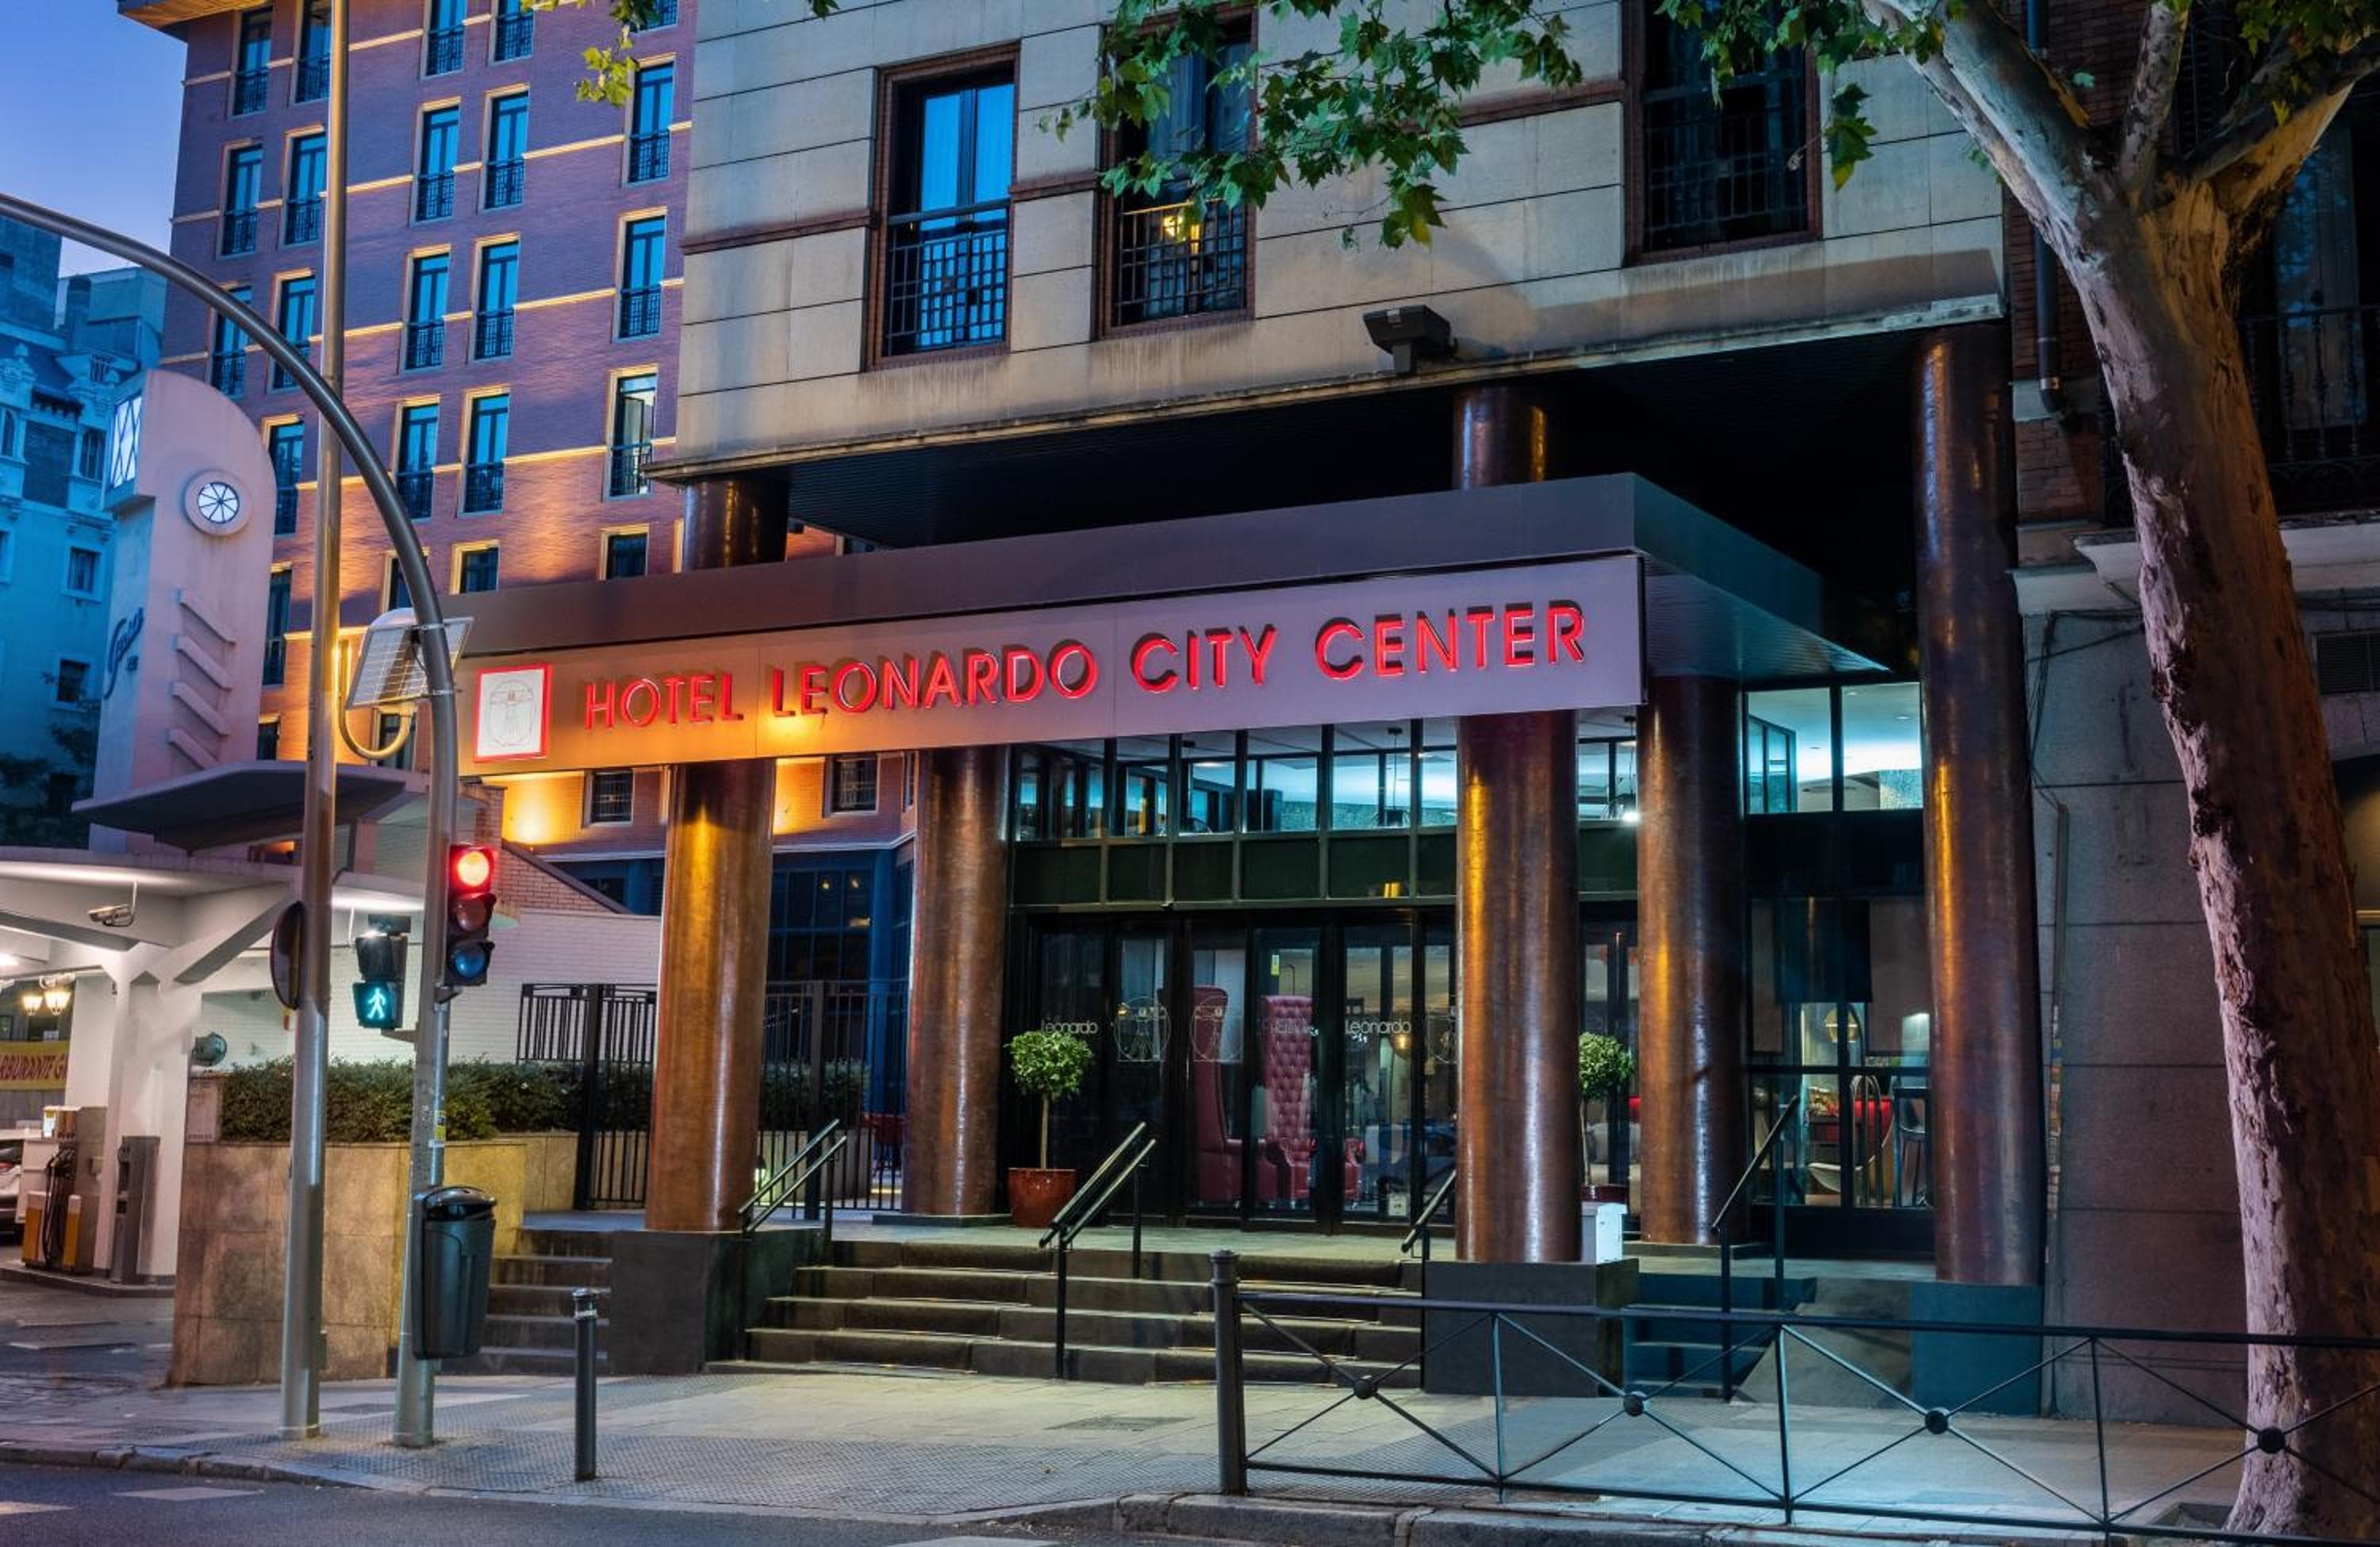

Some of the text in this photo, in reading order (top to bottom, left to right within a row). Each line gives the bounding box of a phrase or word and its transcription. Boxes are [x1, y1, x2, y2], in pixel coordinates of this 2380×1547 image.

[585, 601, 1584, 731] HOTEL LEONARDO CITY CENTER
